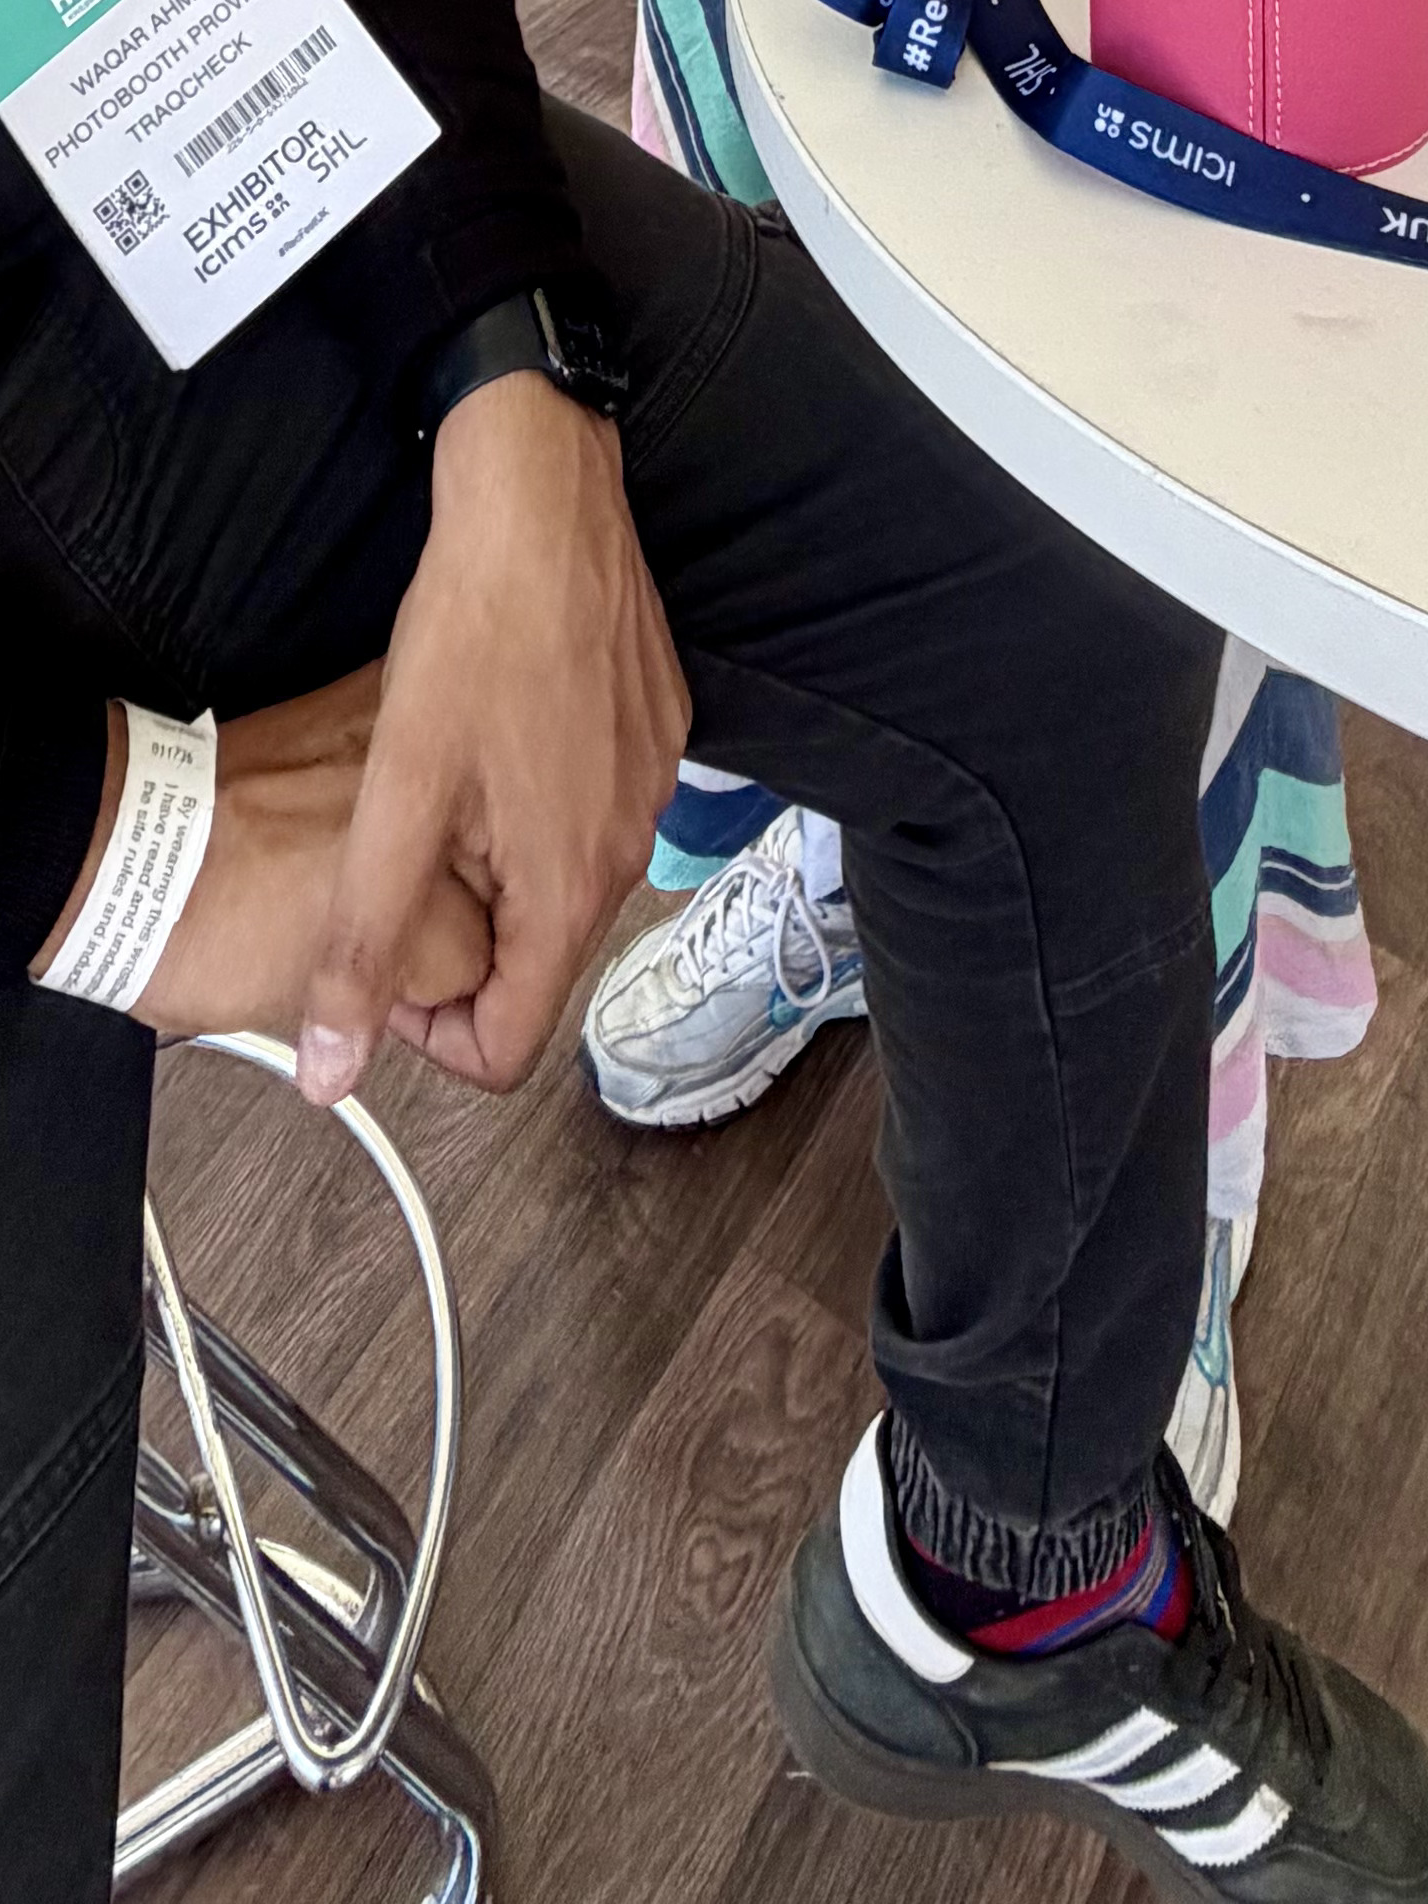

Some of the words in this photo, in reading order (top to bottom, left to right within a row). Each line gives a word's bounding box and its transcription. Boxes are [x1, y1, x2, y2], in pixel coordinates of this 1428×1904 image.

[70, 27, 149, 97] WAQAR
[124, 30, 253, 144] TRAQCHECK
[44, 41, 192, 169] PHOTOBOOTH
[303, 133, 368, 184] SHL
[182, 119, 325, 254] EXHIBITOR
[152, 790, 178, 836] have
[176, 795, 198, 822] By
[111, 845, 138, 897] rules
[137, 839, 162, 890] read
[151, 823, 189, 906] wearing
[92, 901, 118, 940] and
[121, 890, 145, 931] and
[138, 905, 163, 942] this
